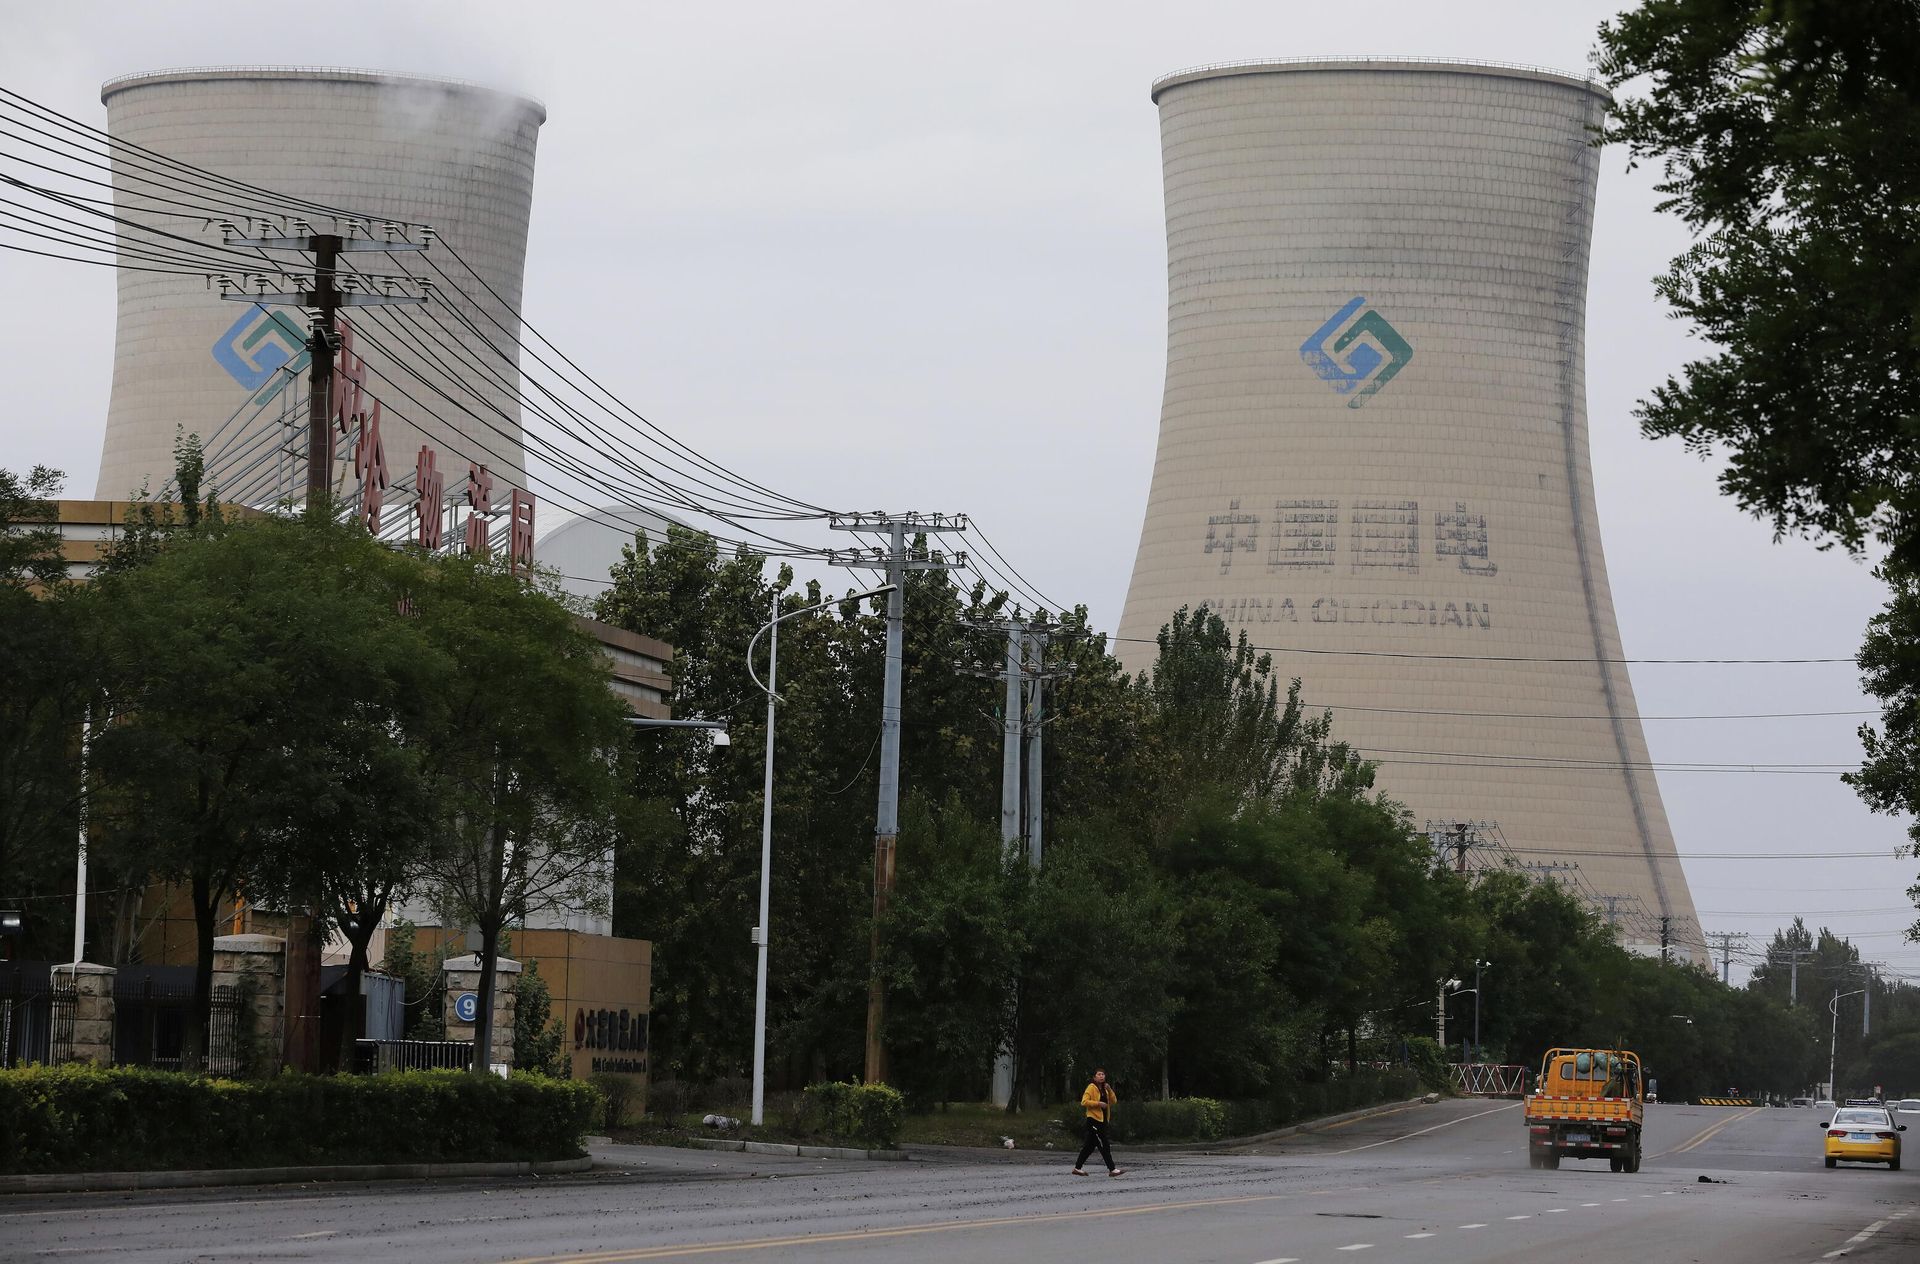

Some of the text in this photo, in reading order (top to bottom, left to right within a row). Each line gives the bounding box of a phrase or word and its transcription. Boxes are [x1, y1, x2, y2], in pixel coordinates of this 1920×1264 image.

[1203, 497, 1498, 578] 中国国电
[1311, 598, 1491, 629] GUODIAN
[463, 999, 475, 1016] 9
